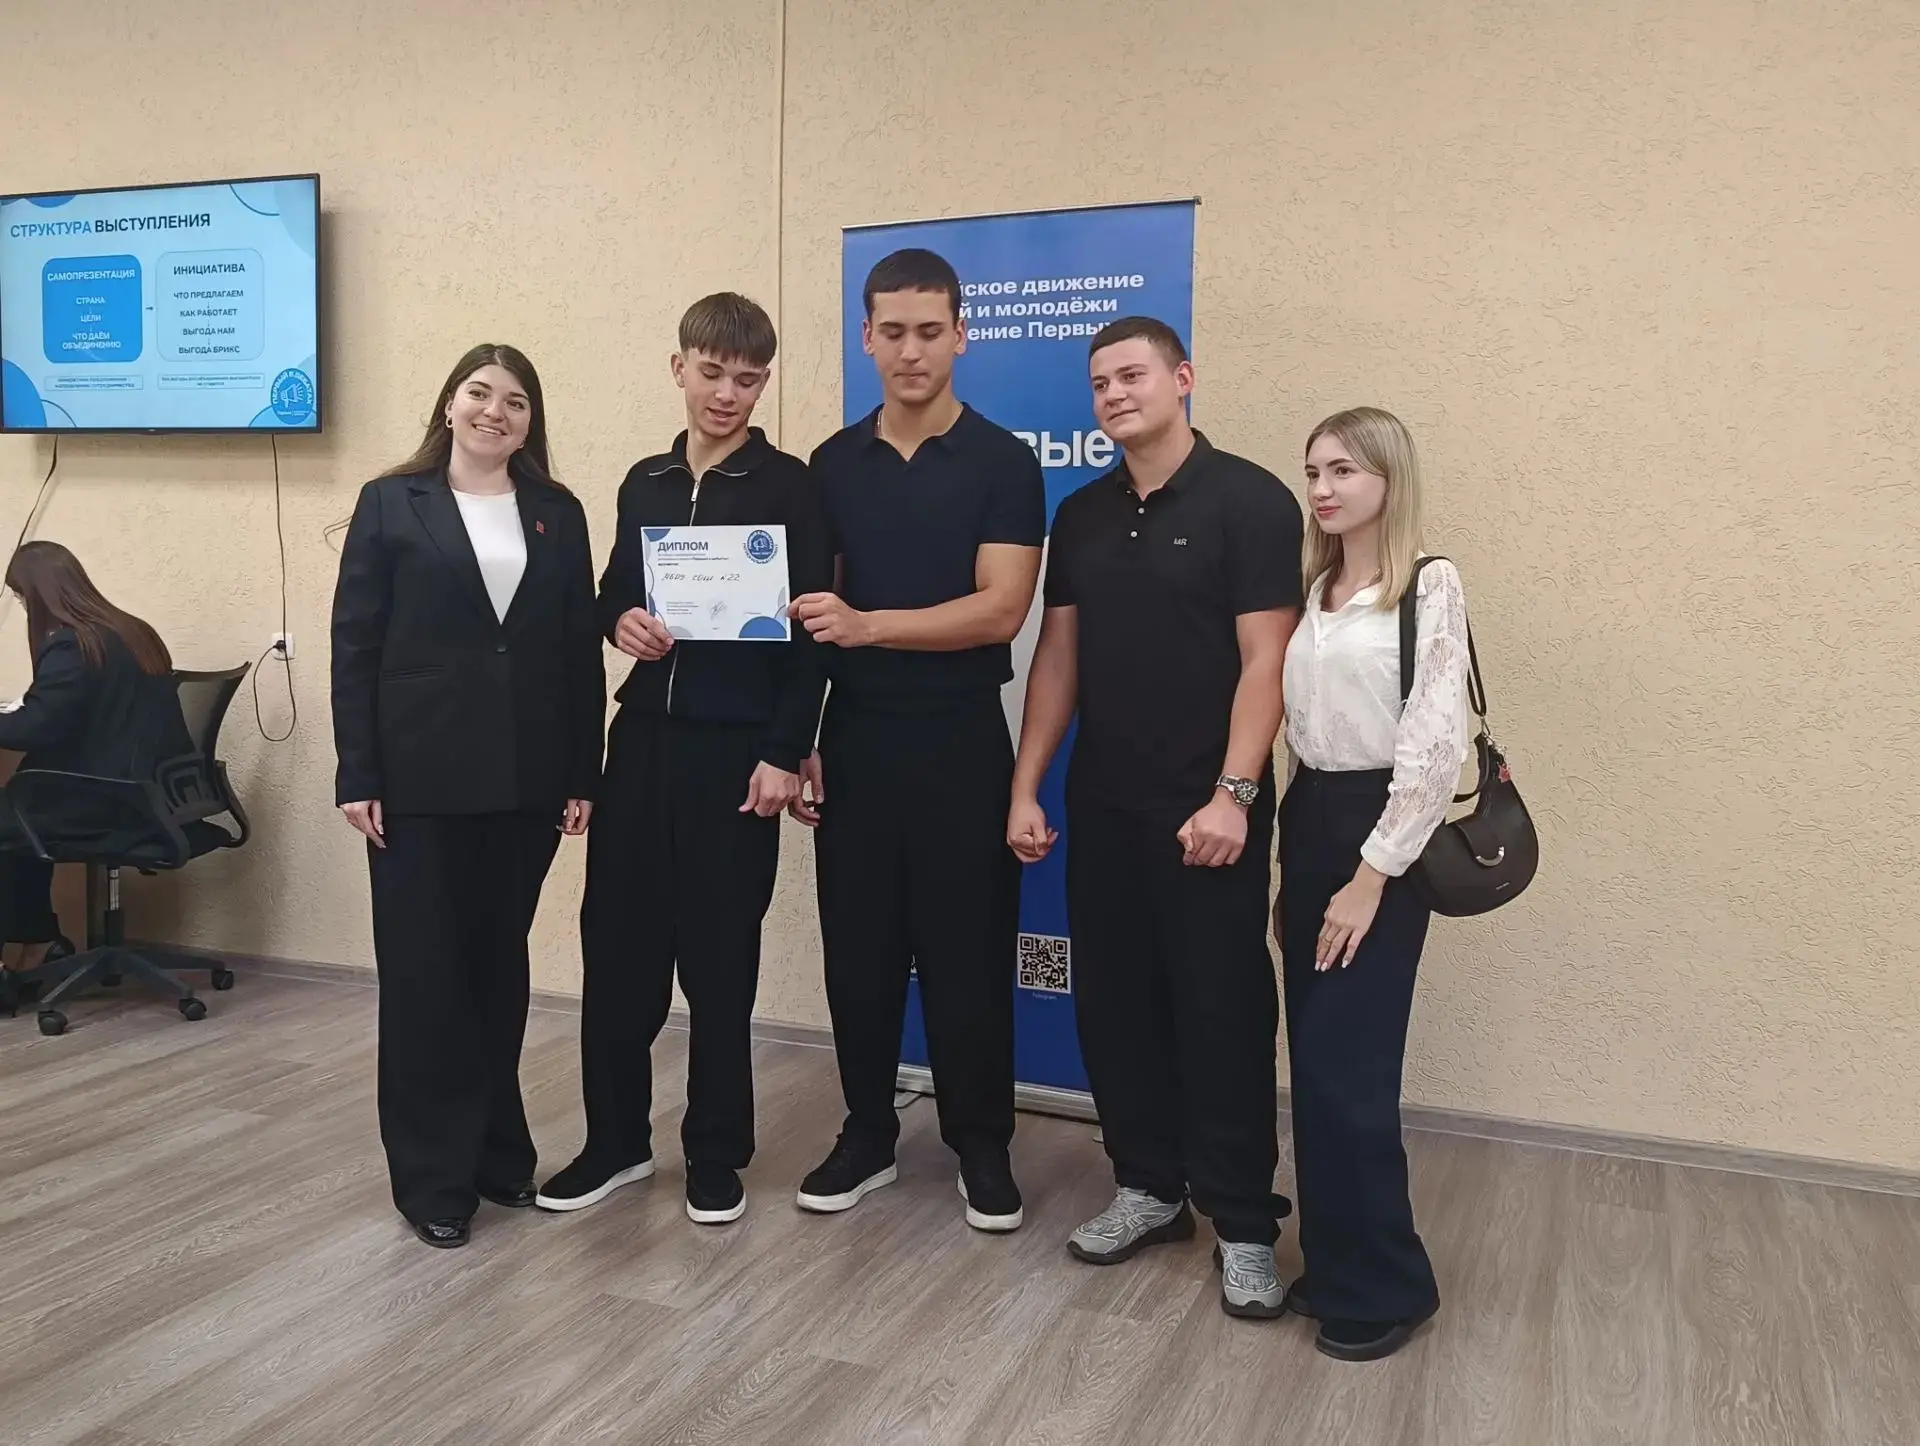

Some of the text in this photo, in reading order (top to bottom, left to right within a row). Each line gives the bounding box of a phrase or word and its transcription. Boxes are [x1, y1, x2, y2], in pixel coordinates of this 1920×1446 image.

[10, 213, 211, 238] СТРУКТУРА ВЫСТУПЛЕНИЯ
[173, 263, 246, 275] ИНИЦИАТИВА
[47, 269, 136, 281] САМОПРЕЗЕНТАЦИЯ
[1021, 273, 1145, 296] движение
[190, 290, 244, 299] ПРЕДЛАГАЕМ
[75, 296, 106, 305] СТРАНА
[976, 305, 990, 318] и
[995, 296, 1118, 317] молодёжи
[179, 308, 238, 317] КАК РАБОТАЕТ
[80, 313, 102, 323] ЦЕЛИ
[182, 327, 235, 336] ВЫГОДА НАМ
[967, 320, 1111, 341] ение Первы
[72, 332, 89, 341] ЧТО
[62, 340, 122, 350] ОБЪЕДИНЕНИЮ
[178, 345, 240, 354] ВЫГОДА БРИКС
[658, 541, 709, 552] ДИПЛОМ
